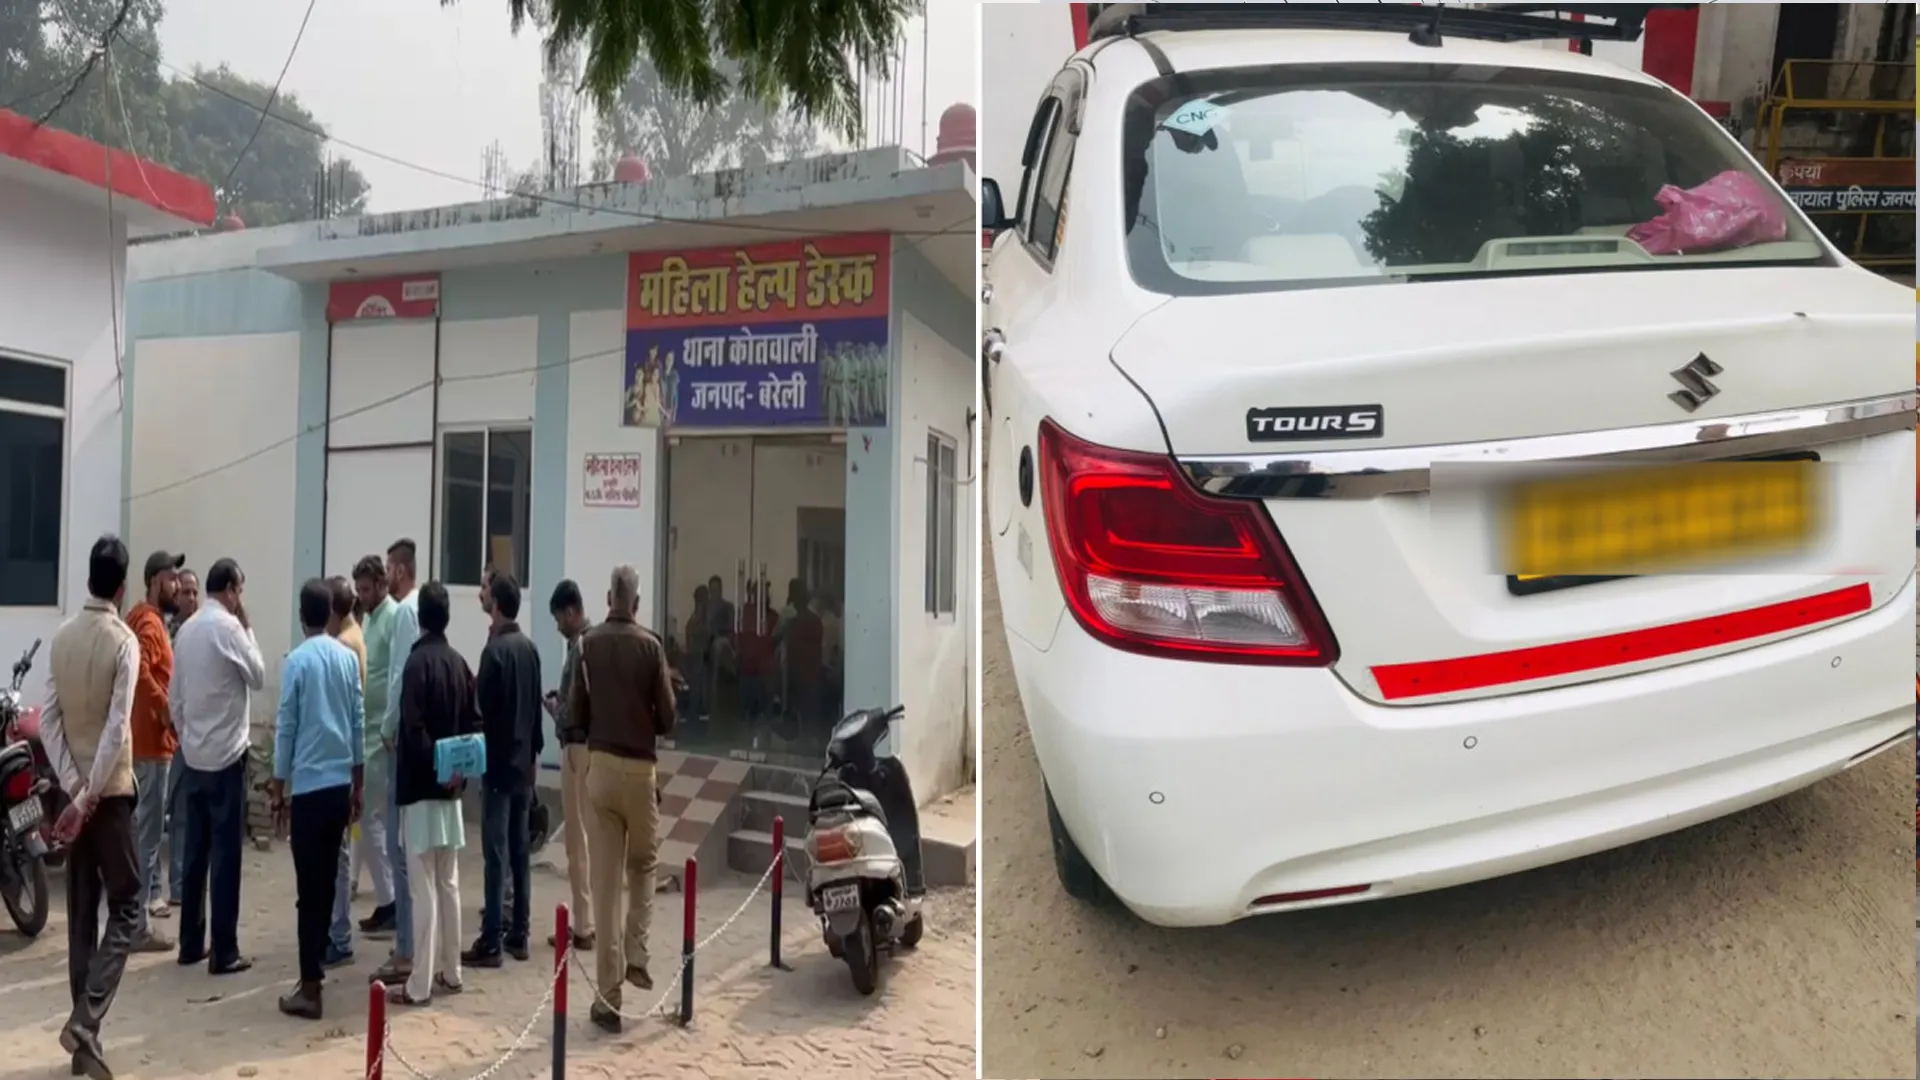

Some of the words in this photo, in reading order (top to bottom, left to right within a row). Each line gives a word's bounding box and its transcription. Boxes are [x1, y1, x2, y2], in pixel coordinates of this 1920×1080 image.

[1836, 185, 1881, 211] पुलिस
[1881, 190, 1916, 208] जनप
[639, 256, 730, 316] महिला
[735, 249, 800, 312] हेल्प
[804, 243, 876, 307] डेस्क
[682, 335, 726, 367] थाना
[729, 323, 818, 366] कोतवाली
[758, 372, 807, 410] बरेली
